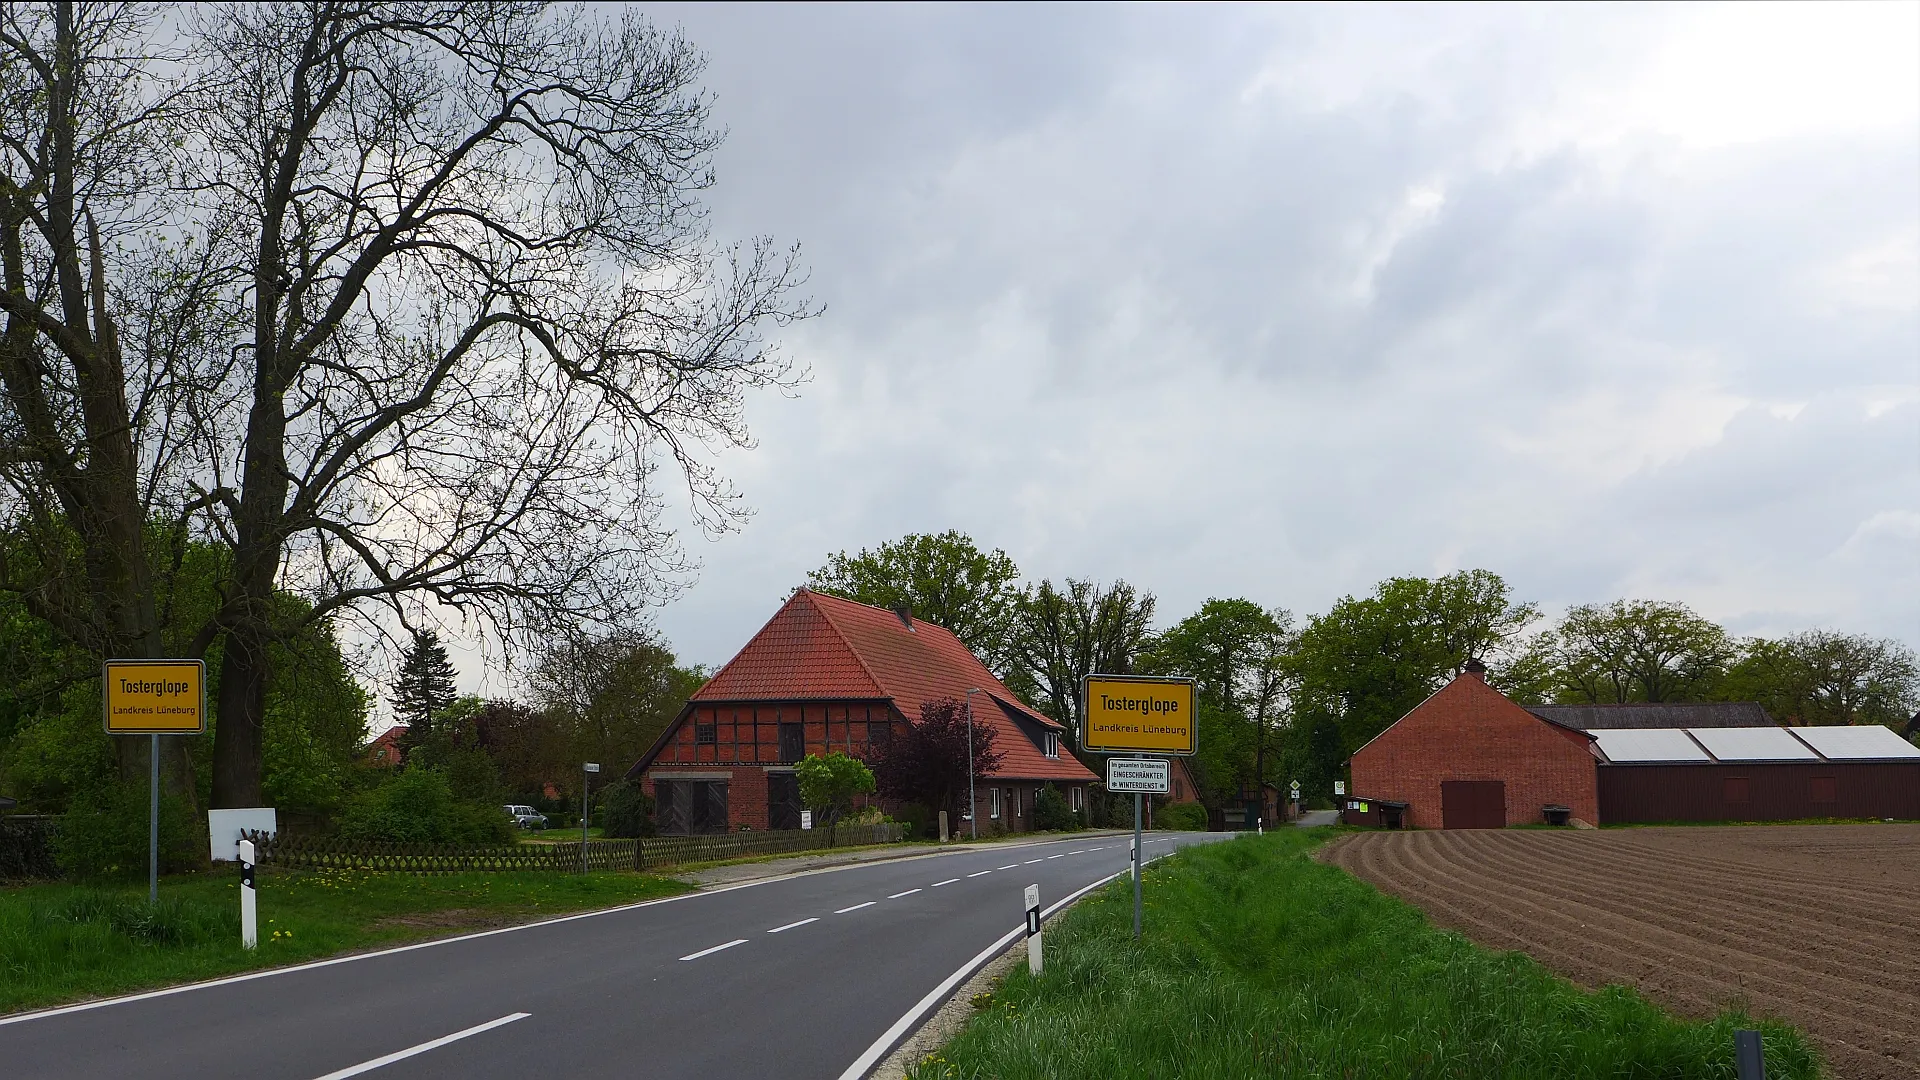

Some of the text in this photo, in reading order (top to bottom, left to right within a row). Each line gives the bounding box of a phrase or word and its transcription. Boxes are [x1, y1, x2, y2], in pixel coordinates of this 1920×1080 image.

[120, 679, 188, 697] Tosterglope
[1101, 695, 1178, 715] Tosterglope
[113, 706, 195, 716] Landkreis Lüneburg
[1093, 723, 1187, 736] Landkreis Lüneburg
[1113, 771, 1164, 780] EINGESCHRÄNKTER
[1119, 781, 1158, 790] WINTERDIENST
